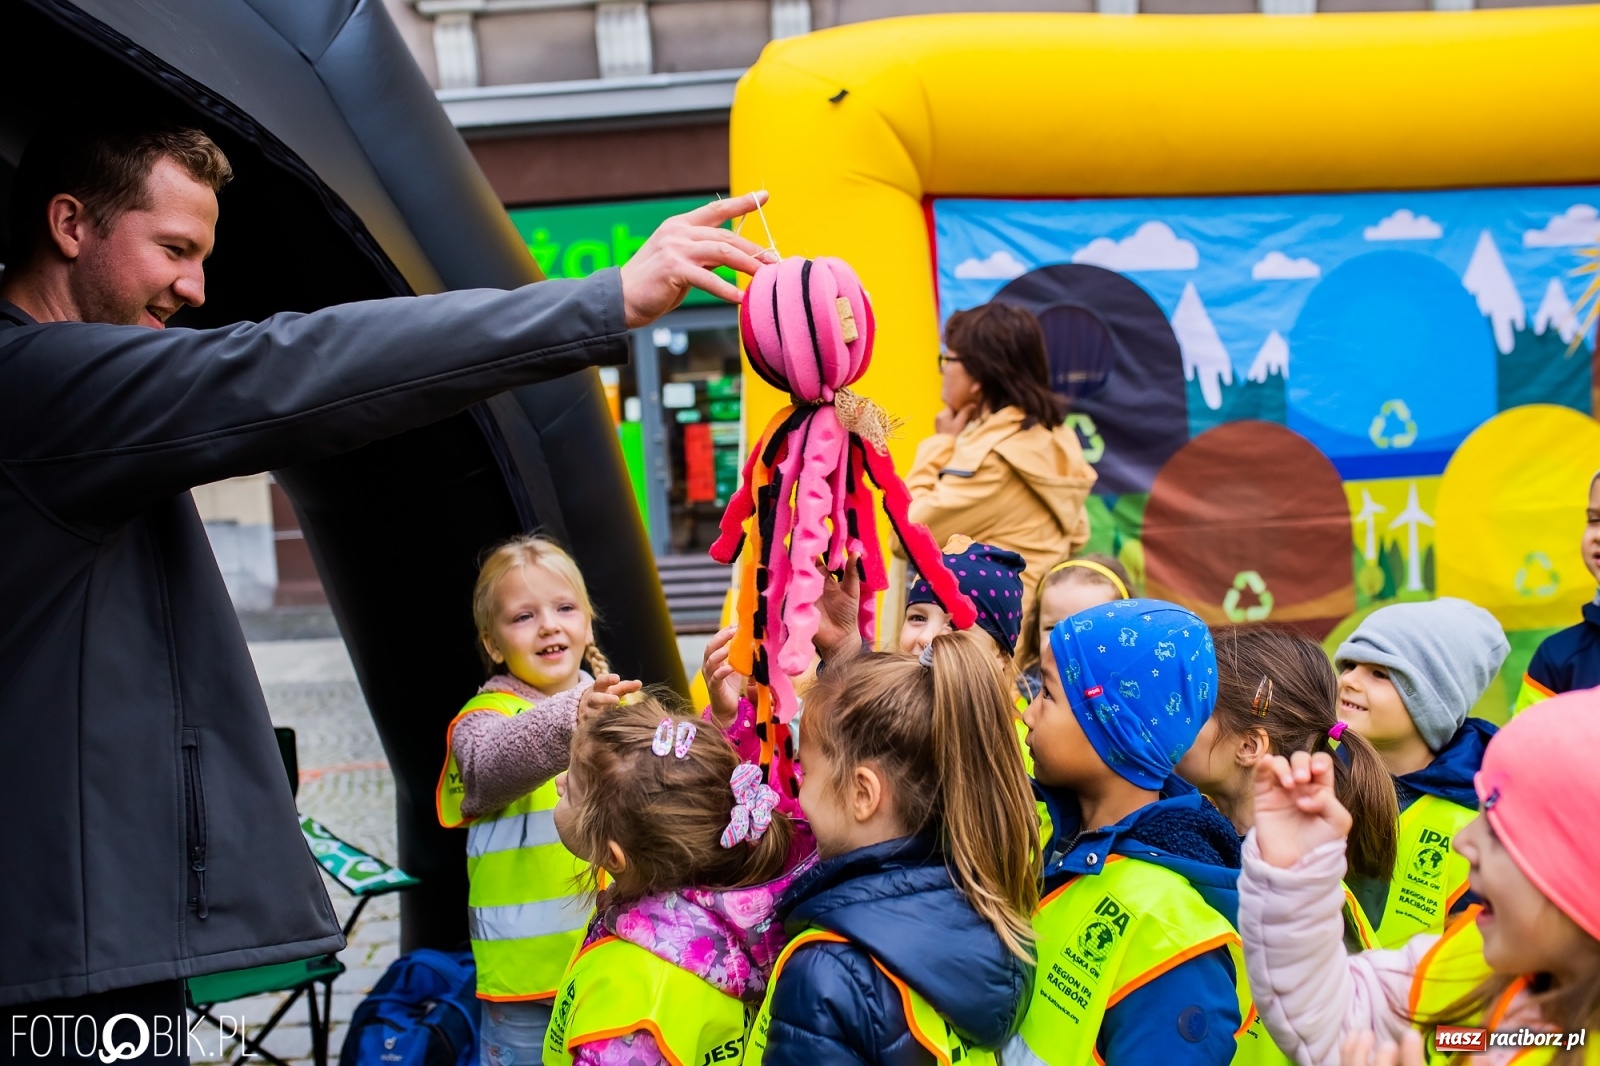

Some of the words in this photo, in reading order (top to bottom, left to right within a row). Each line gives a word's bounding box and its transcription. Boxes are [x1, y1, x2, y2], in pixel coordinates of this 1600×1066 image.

[1419, 829, 1450, 853] IPA
[1399, 895, 1436, 916] RACIBÓRZ
[1401, 888, 1425, 902] REGION
[1427, 898, 1438, 907] IPA
[1094, 896, 1130, 937] IPA
[1064, 947, 1089, 970] ŚLĄSKA
[1089, 967, 1100, 979] GW
[1047, 972, 1088, 1010] RACIBÓRZ
[1052, 963, 1081, 989] REGION
[1081, 985, 1092, 1000] IPA
